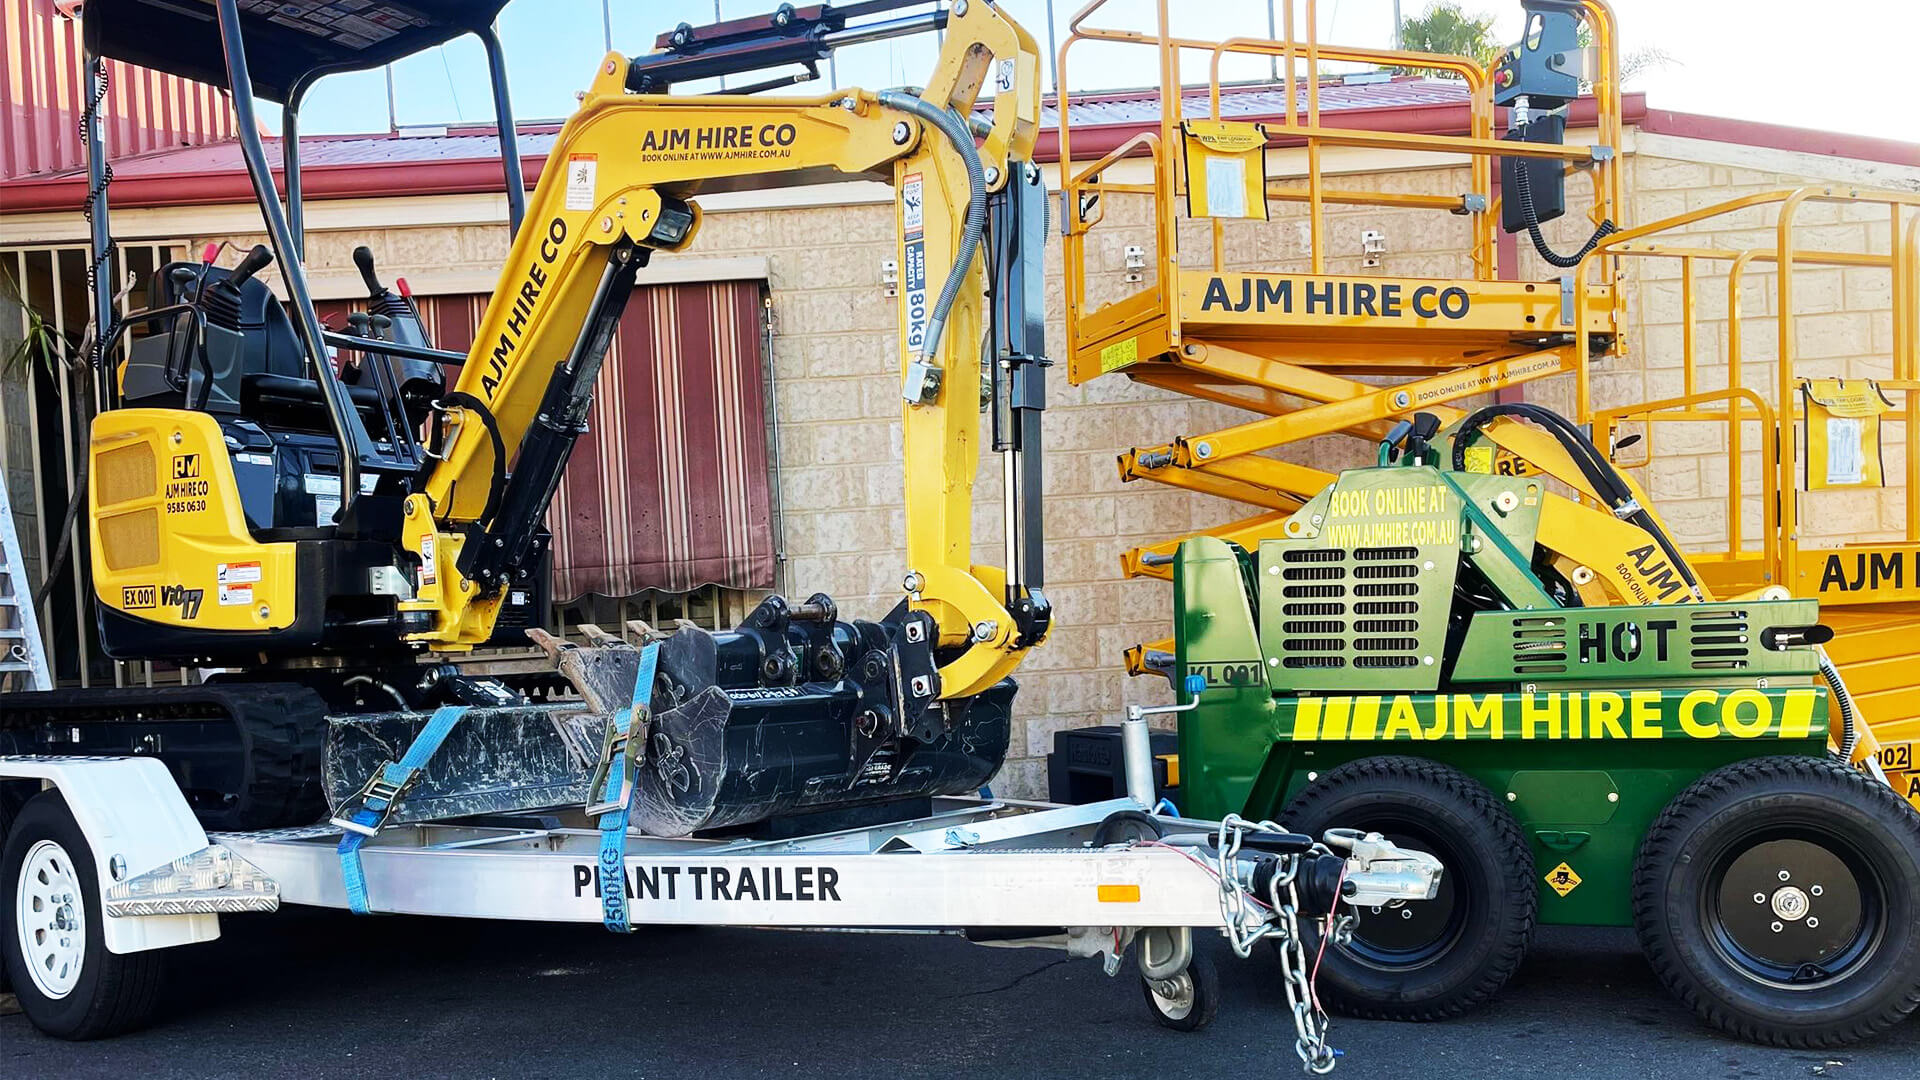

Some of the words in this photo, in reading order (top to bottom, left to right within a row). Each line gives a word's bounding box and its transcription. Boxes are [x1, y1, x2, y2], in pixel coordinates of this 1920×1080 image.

[641, 129, 690, 151] AJM
[696, 126, 753, 149] HIRE
[759, 124, 797, 146] CO
[642, 154, 662, 162] BOOK
[663, 153, 688, 162] ONLINE
[690, 152, 700, 160] AT
[700, 149, 791, 160] WWW.AJMHIRE.COM.AU
[906, 245, 917, 290] CAPACITY
[915, 250, 924, 280] RATED
[481, 333, 516, 400] AJM
[507, 262, 548, 337] HIRE
[540, 217, 567, 264] CO
[1201, 277, 1293, 313] AJM
[1305, 281, 1402, 317] HIRE
[1411, 285, 1470, 319] CO
[908, 292, 925, 347] 80kg
[1418, 389, 1440, 401] BOOK
[1439, 382, 1467, 395] ONLINE
[1467, 380, 1476, 389] AT
[1497, 456, 1527, 477] RE
[165, 483, 180, 499] AJM
[180, 481, 197, 498] HIRE
[197, 480, 209, 496] CO
[166, 501, 186, 514] 9585
[186, 499, 206, 513] 0630
[1331, 490, 1370, 518] BOOK
[1375, 486, 1426, 516] ONLINE
[1428, 484, 1448, 513] AT
[1327, 519, 1456, 548] WWW.AJMHIRE.COM.AU
[1615, 562, 1634, 586] BOOK
[1630, 583, 1652, 606] ONLIN
[1625, 544, 1683, 600] AJM
[1819, 552, 1903, 592] AJM
[124, 590, 138, 606] EX
[137, 589, 155, 605] 001
[1579, 620, 1678, 664] HOT
[1222, 664, 1259, 685] 001
[1383, 694, 1504, 741] AJM
[1521, 692, 1663, 740] HIRE
[1678, 689, 1772, 739] CO
[602, 848, 625, 932] 2500KG
[688, 866, 842, 902] TRAILER
